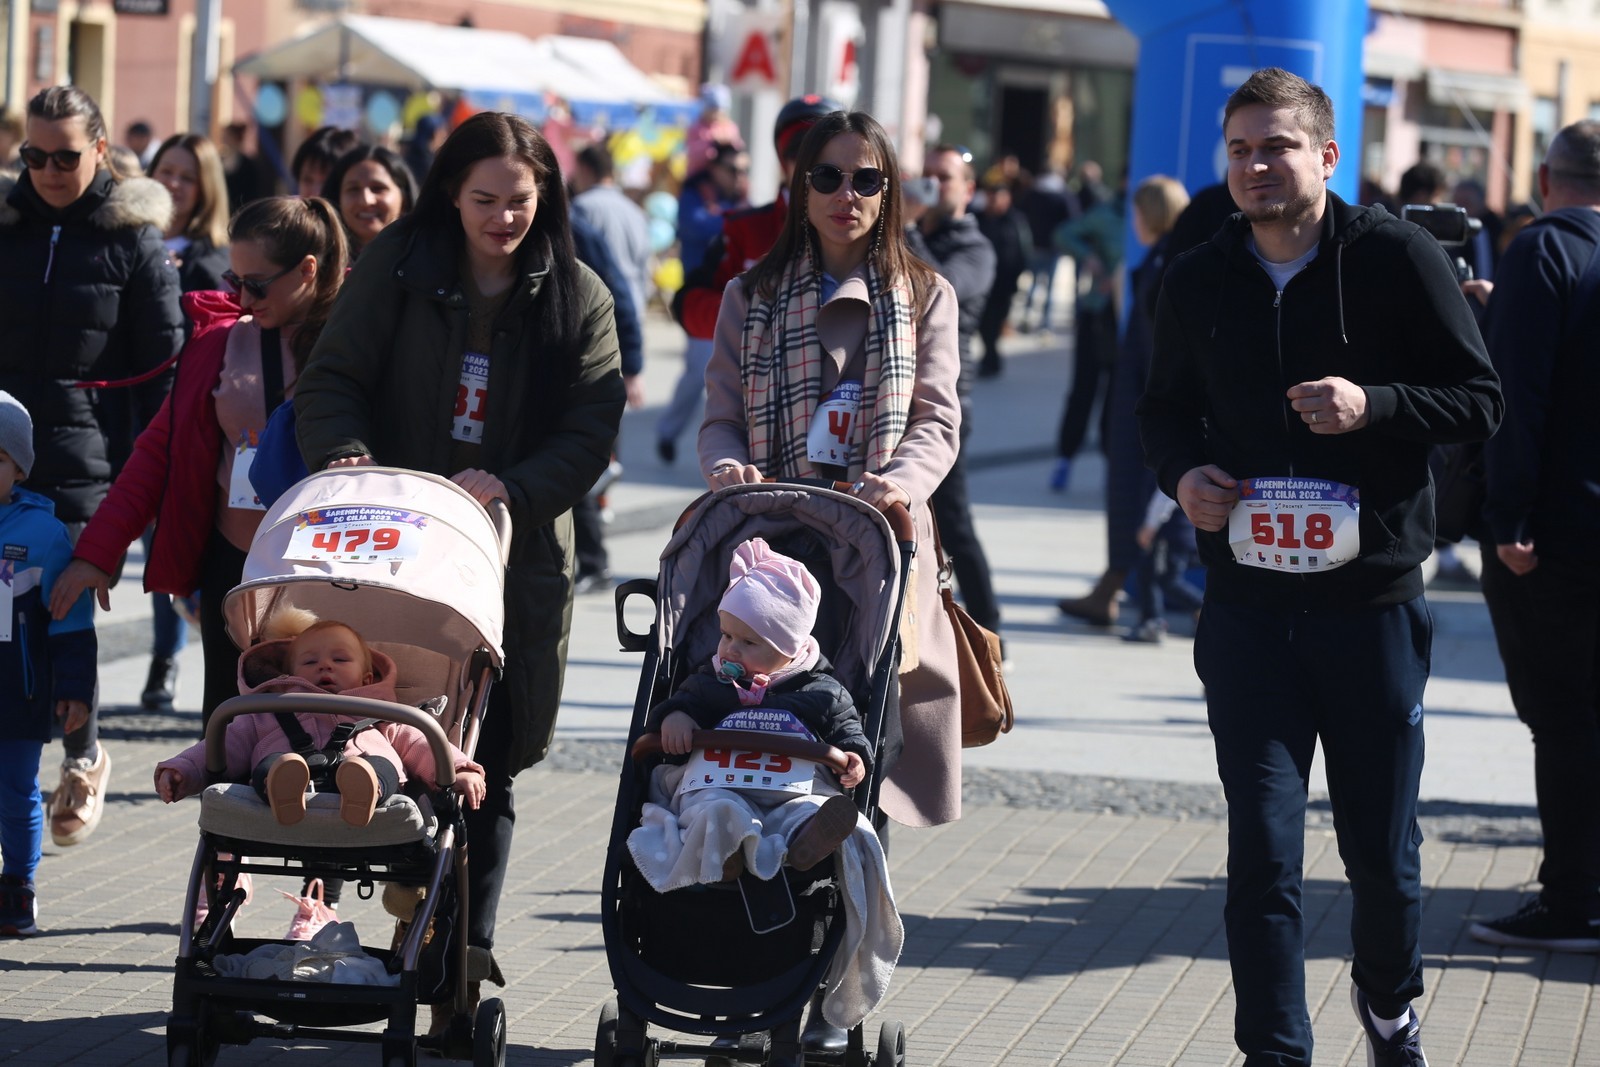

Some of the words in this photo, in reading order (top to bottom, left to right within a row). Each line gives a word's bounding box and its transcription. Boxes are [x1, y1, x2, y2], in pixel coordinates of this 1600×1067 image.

[731, 29, 777, 83] A
[840, 391, 851, 400] DO
[828, 410, 858, 446] 4
[1254, 479, 1286, 490] ŠARENIM
[1287, 478, 1332, 491] ČARAPAMA
[1262, 490, 1273, 499] DO
[1274, 490, 1297, 500] CILJA
[1298, 490, 1323, 500] 2023.
[325, 509, 359, 517] ŠARENIM
[359, 507, 402, 516] ČARAPAMA
[1250, 513, 1335, 550] 518
[311, 527, 401, 553] 479
[748, 709, 791, 722] ČARAPAMA
[735, 720, 757, 729] CILJA
